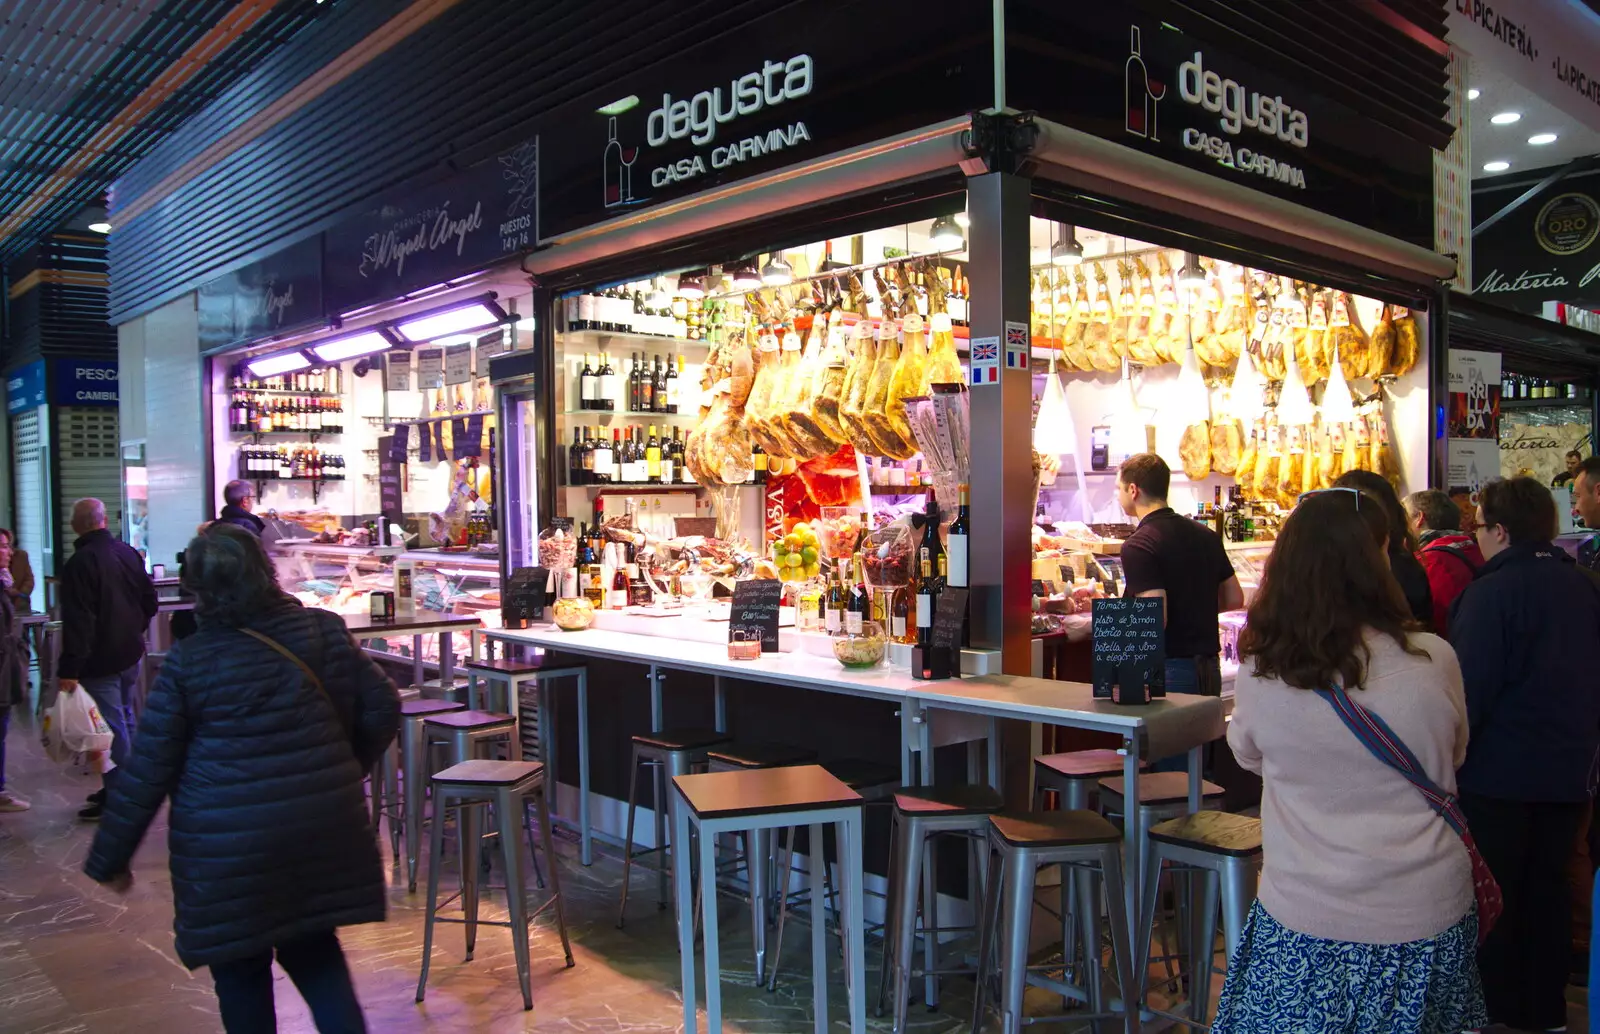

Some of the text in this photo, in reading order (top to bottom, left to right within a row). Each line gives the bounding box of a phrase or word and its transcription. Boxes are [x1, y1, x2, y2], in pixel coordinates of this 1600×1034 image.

[647, 54, 813, 147] degusta
[1179, 51, 1308, 148] degusta
[652, 121, 811, 188] CASA CARMINA
[1183, 128, 1306, 189] CASA CARMINA
[500, 214, 531, 237] PUESTOS
[1549, 217, 1588, 234] ORO
[374, 200, 482, 277] Miguel Ángel
[503, 232, 528, 251] 14 y 16
[1472, 267, 1569, 294] Materia
[1467, 399, 1492, 415] LLA
[1466, 414, 1485, 429] DA
[1498, 432, 1561, 451] ateria
[1132, 599, 1146, 613] hoy
[1094, 615, 1114, 628] plato
[1118, 615, 1127, 624] de
[1125, 629, 1137, 638] con
[1094, 640, 1157, 652] botella de vino
[1106, 651, 1131, 667] elegir
[1134, 654, 1148, 666] por
